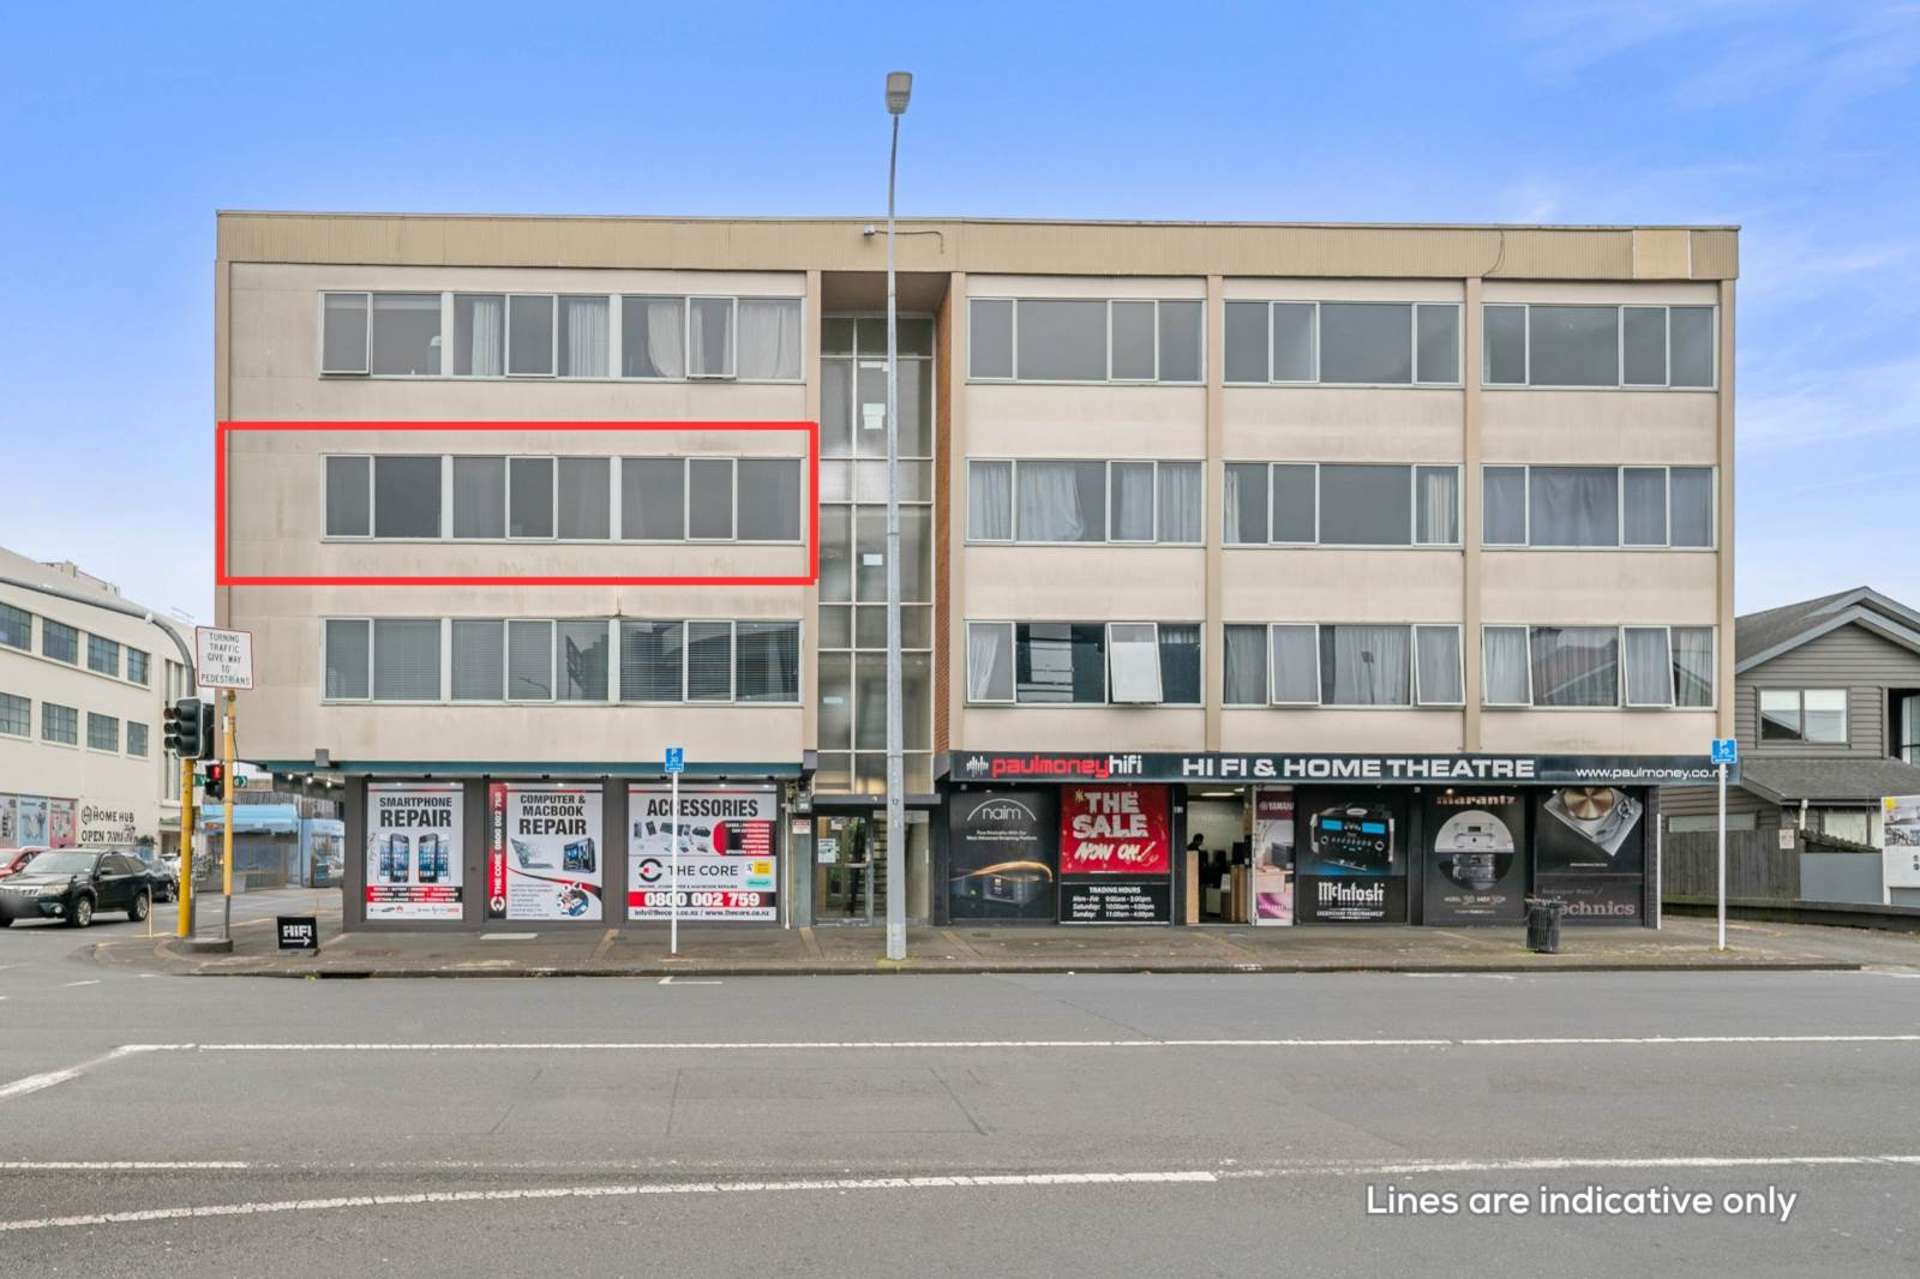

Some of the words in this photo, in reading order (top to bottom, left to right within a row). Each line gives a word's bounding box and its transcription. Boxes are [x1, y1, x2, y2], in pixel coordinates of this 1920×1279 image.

[209, 631, 240, 643] TURNING
[210, 642, 241, 654] TRAFFIC
[207, 652, 224, 662] GIVE
[228, 655, 241, 664] WAY
[221, 663, 231, 673] TO
[201, 673, 250, 686] PEDESTRIANS
[1182, 758, 1214, 776] HI
[1221, 758, 1247, 776] FI
[1253, 758, 1277, 776] &
[1284, 758, 1381, 777] HOME
[1386, 759, 1535, 777] THEATRE
[1575, 768, 1729, 780] www.paulmoney.co.n
[379, 797, 453, 807] SMARTPHONE
[520, 795, 575, 804] COMPUTER
[578, 795, 586, 804] &
[1084, 791, 1140, 814] THE
[93, 810, 118, 822] HOME
[119, 811, 135, 823] HUB
[522, 805, 584, 816] MACBOOK
[982, 805, 1021, 820] naim
[380, 809, 452, 827] REPAIR
[519, 819, 586, 835] REPAIR
[1072, 814, 1149, 839] SALE
[81, 830, 105, 842] OPEN
[1074, 841, 1114, 862] NOW
[667, 865, 695, 876] THE
[699, 865, 739, 876] CORE
[691, 893, 724, 907] 002
[727, 893, 761, 907] 759
[283, 925, 312, 937] HIFI
